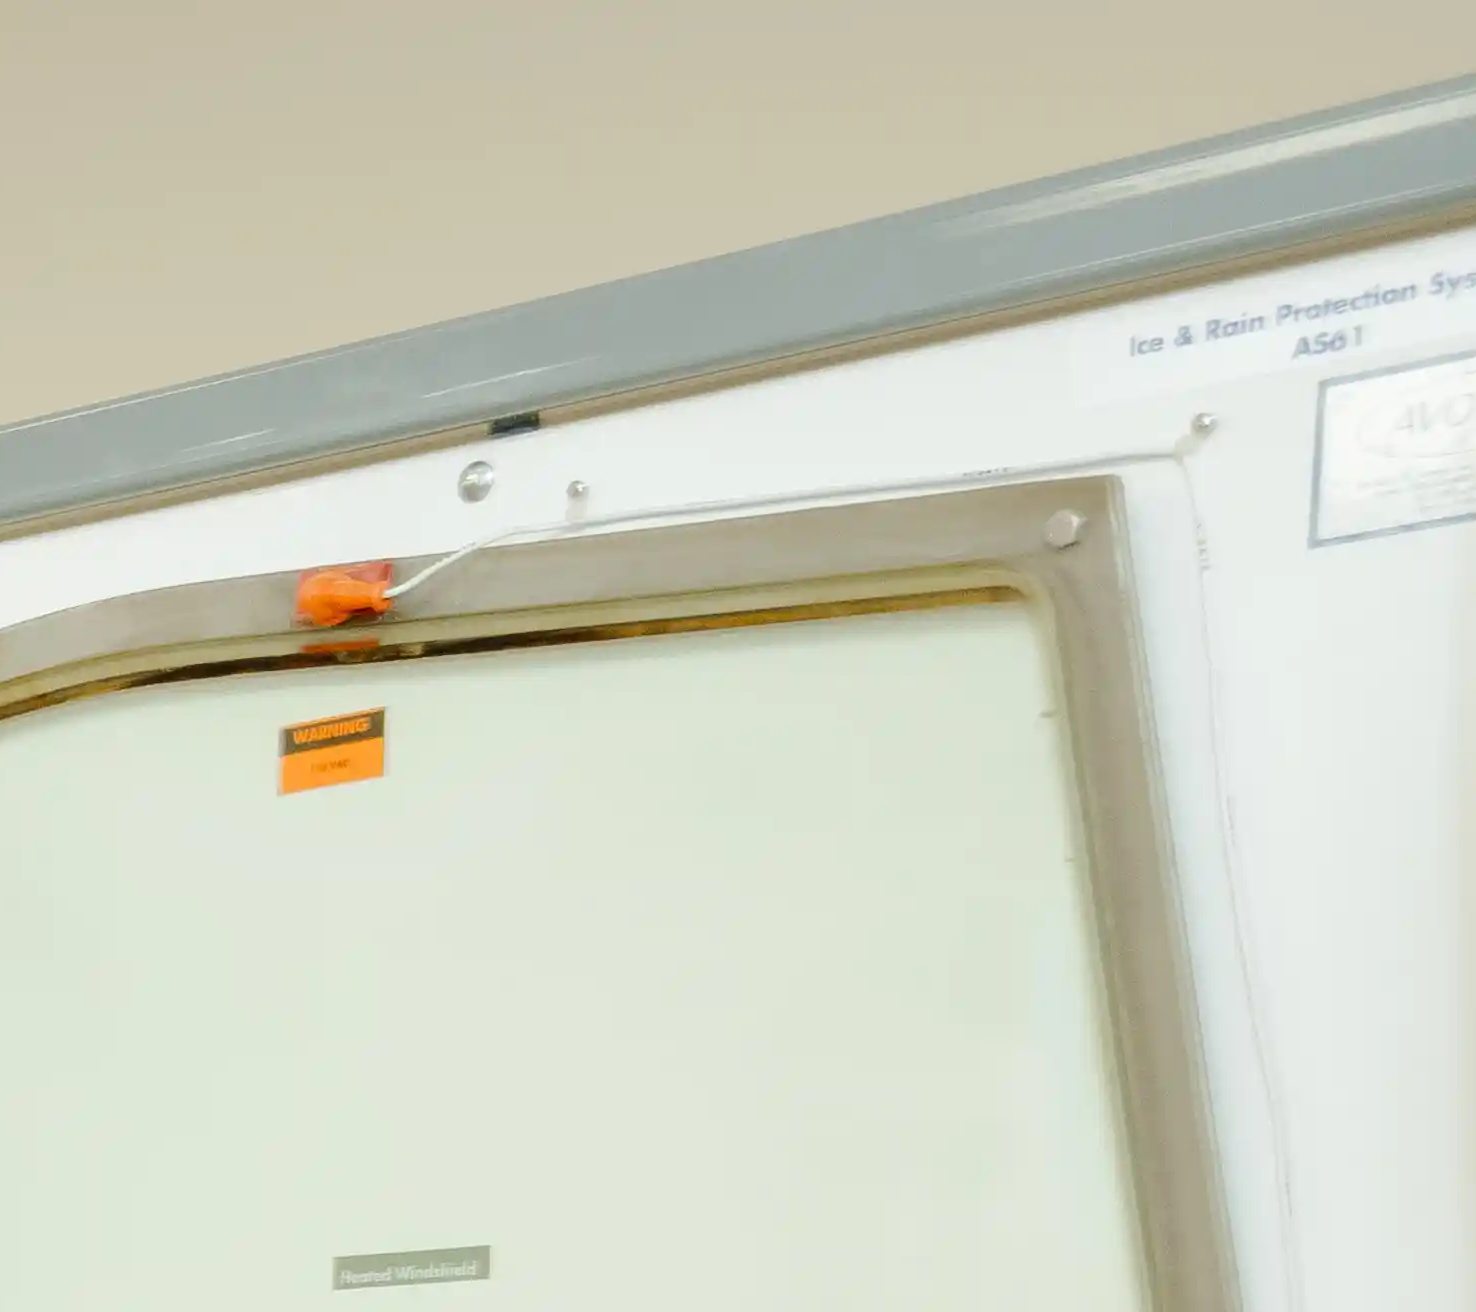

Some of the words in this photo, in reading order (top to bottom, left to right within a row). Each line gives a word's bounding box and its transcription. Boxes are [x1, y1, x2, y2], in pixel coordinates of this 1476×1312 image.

[1128, 334, 1165, 357] Ice
[1174, 325, 1194, 347] &
[1205, 311, 1265, 342] Rain
[1275, 281, 1418, 327] Protection
[292, 715, 371, 745] WARNING
[340, 1266, 392, 1285] Heated
[395, 1259, 478, 1281] Windshield
